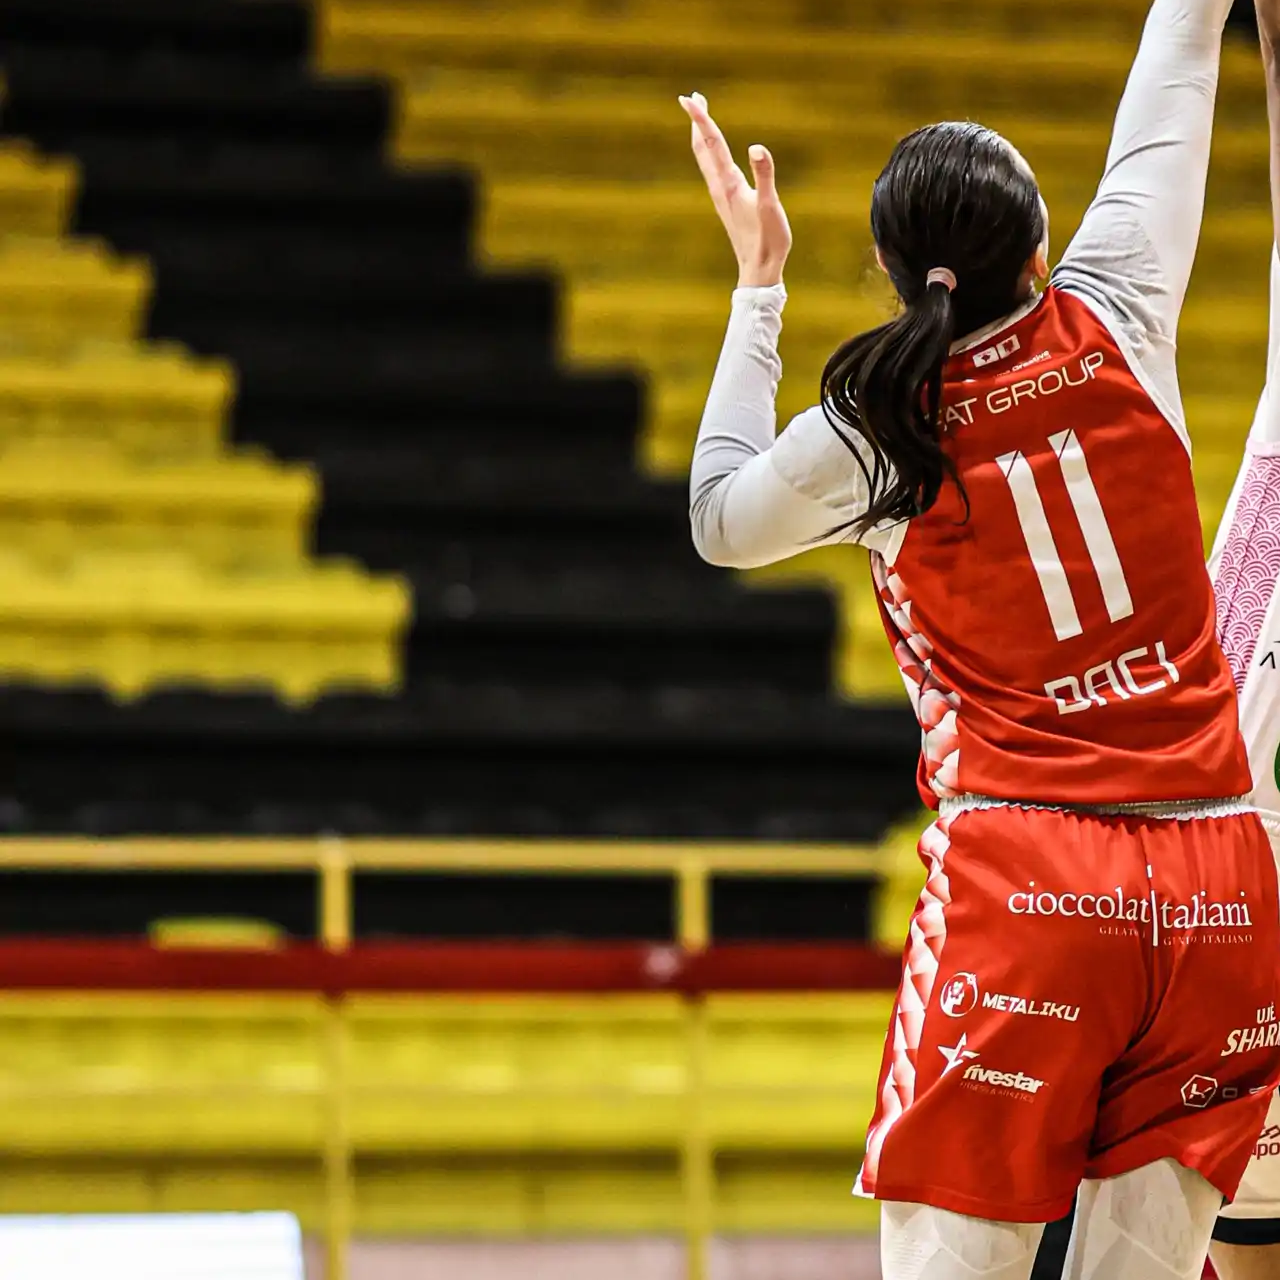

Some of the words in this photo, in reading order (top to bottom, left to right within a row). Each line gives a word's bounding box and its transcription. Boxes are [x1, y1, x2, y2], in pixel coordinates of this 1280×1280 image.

[985, 351, 1104, 414] GROUP
[995, 428, 1134, 642] 11
[1044, 641, 1180, 715] DACI
[982, 992, 1080, 1022] METALIKU
[962, 1064, 1044, 1093] fivestar
